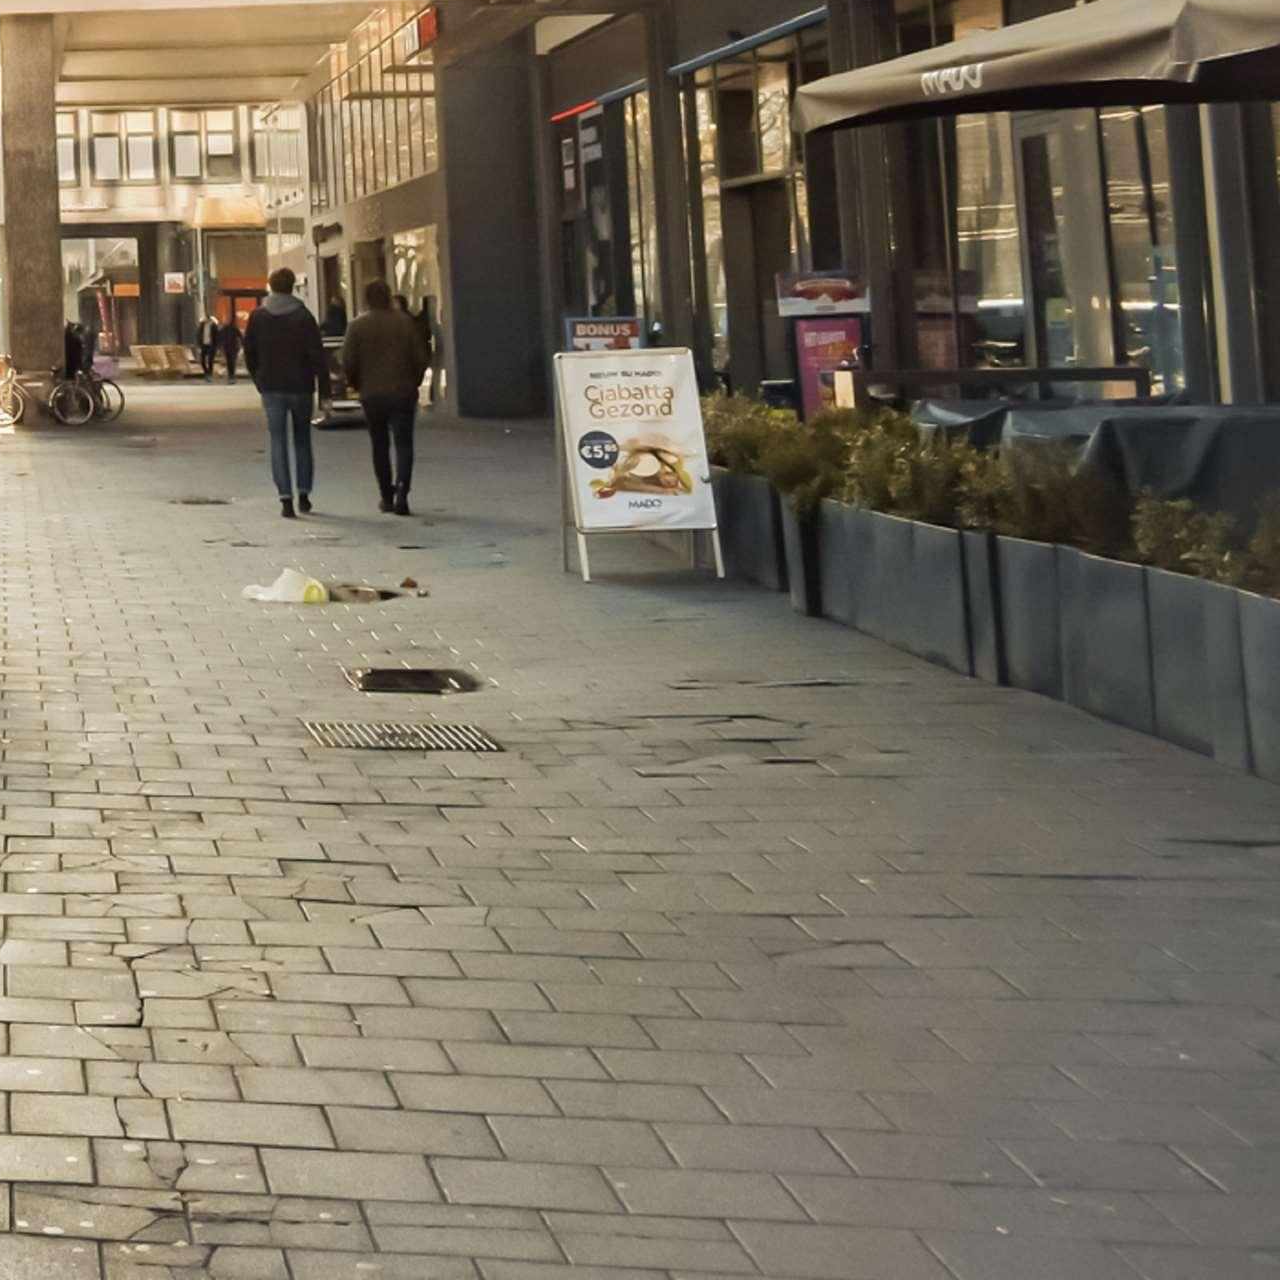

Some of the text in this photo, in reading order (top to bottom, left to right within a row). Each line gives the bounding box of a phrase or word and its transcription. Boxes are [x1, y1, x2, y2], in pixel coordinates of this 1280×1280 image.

[575, 323, 632, 336] BONUS
[584, 384, 674, 402] Ciabatta
[589, 397, 673, 418] Gezond
[628, 498, 663, 510] MADO
